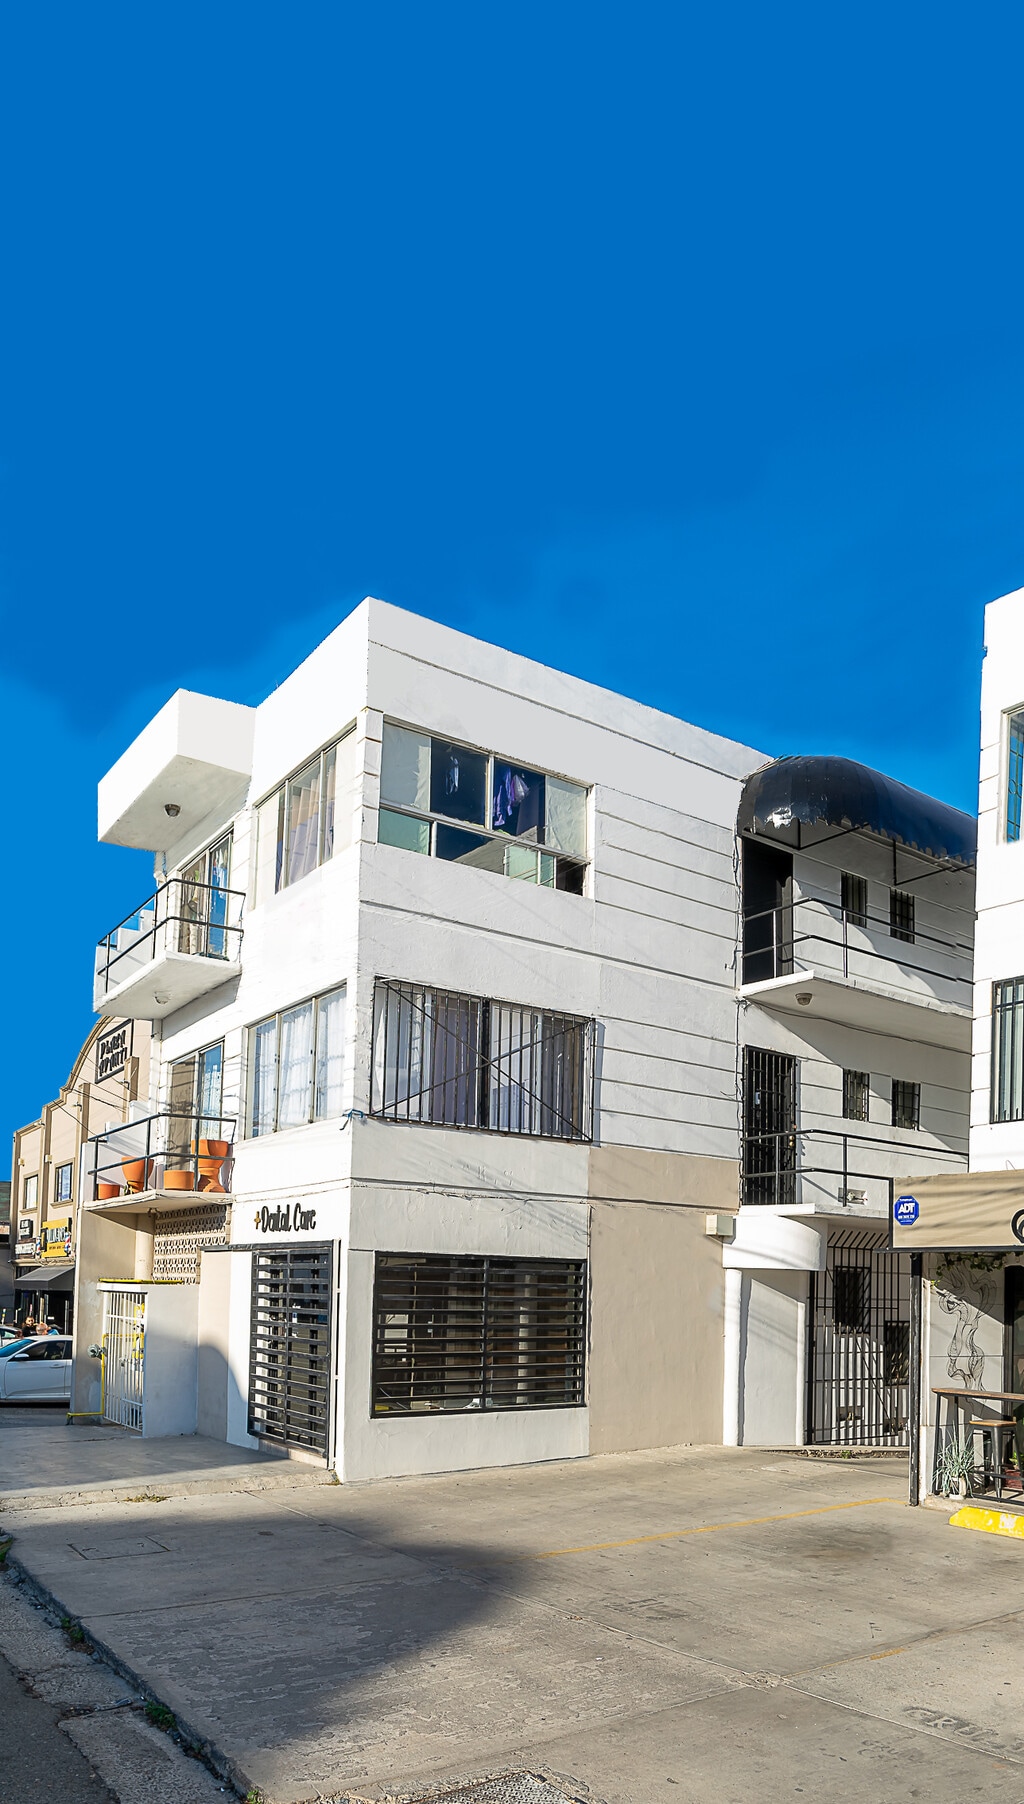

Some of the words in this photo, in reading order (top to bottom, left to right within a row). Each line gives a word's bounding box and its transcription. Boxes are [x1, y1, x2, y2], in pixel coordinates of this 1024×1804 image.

[261, 1205, 292, 1233] Dental
[293, 1202, 316, 1232] Care
[898, 1202, 916, 1214] ADT
